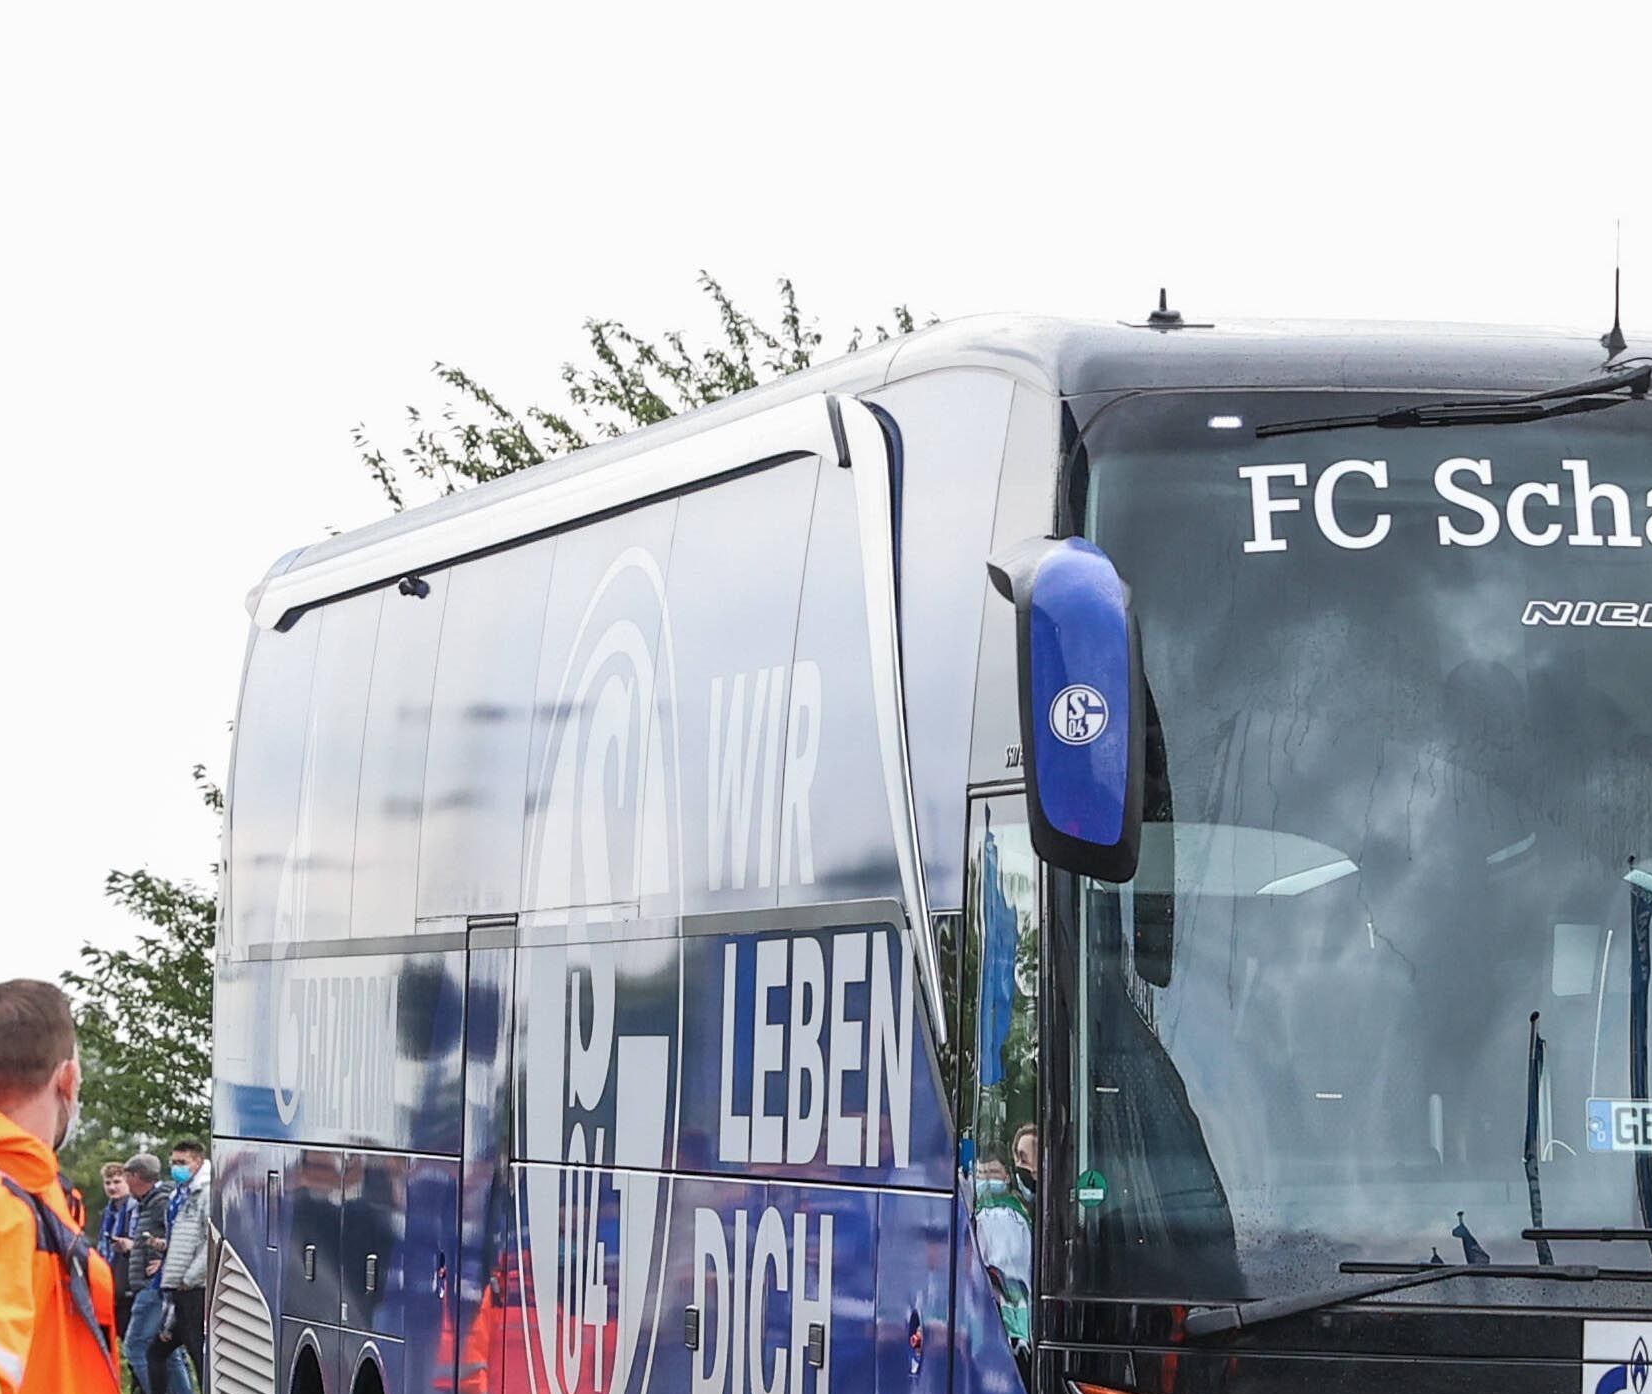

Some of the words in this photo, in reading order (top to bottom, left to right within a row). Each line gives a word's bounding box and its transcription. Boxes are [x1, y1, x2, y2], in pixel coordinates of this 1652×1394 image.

[1238, 458, 1392, 554] FC
[707, 660, 824, 891] WIR
[718, 931, 915, 1169] LEBEN
